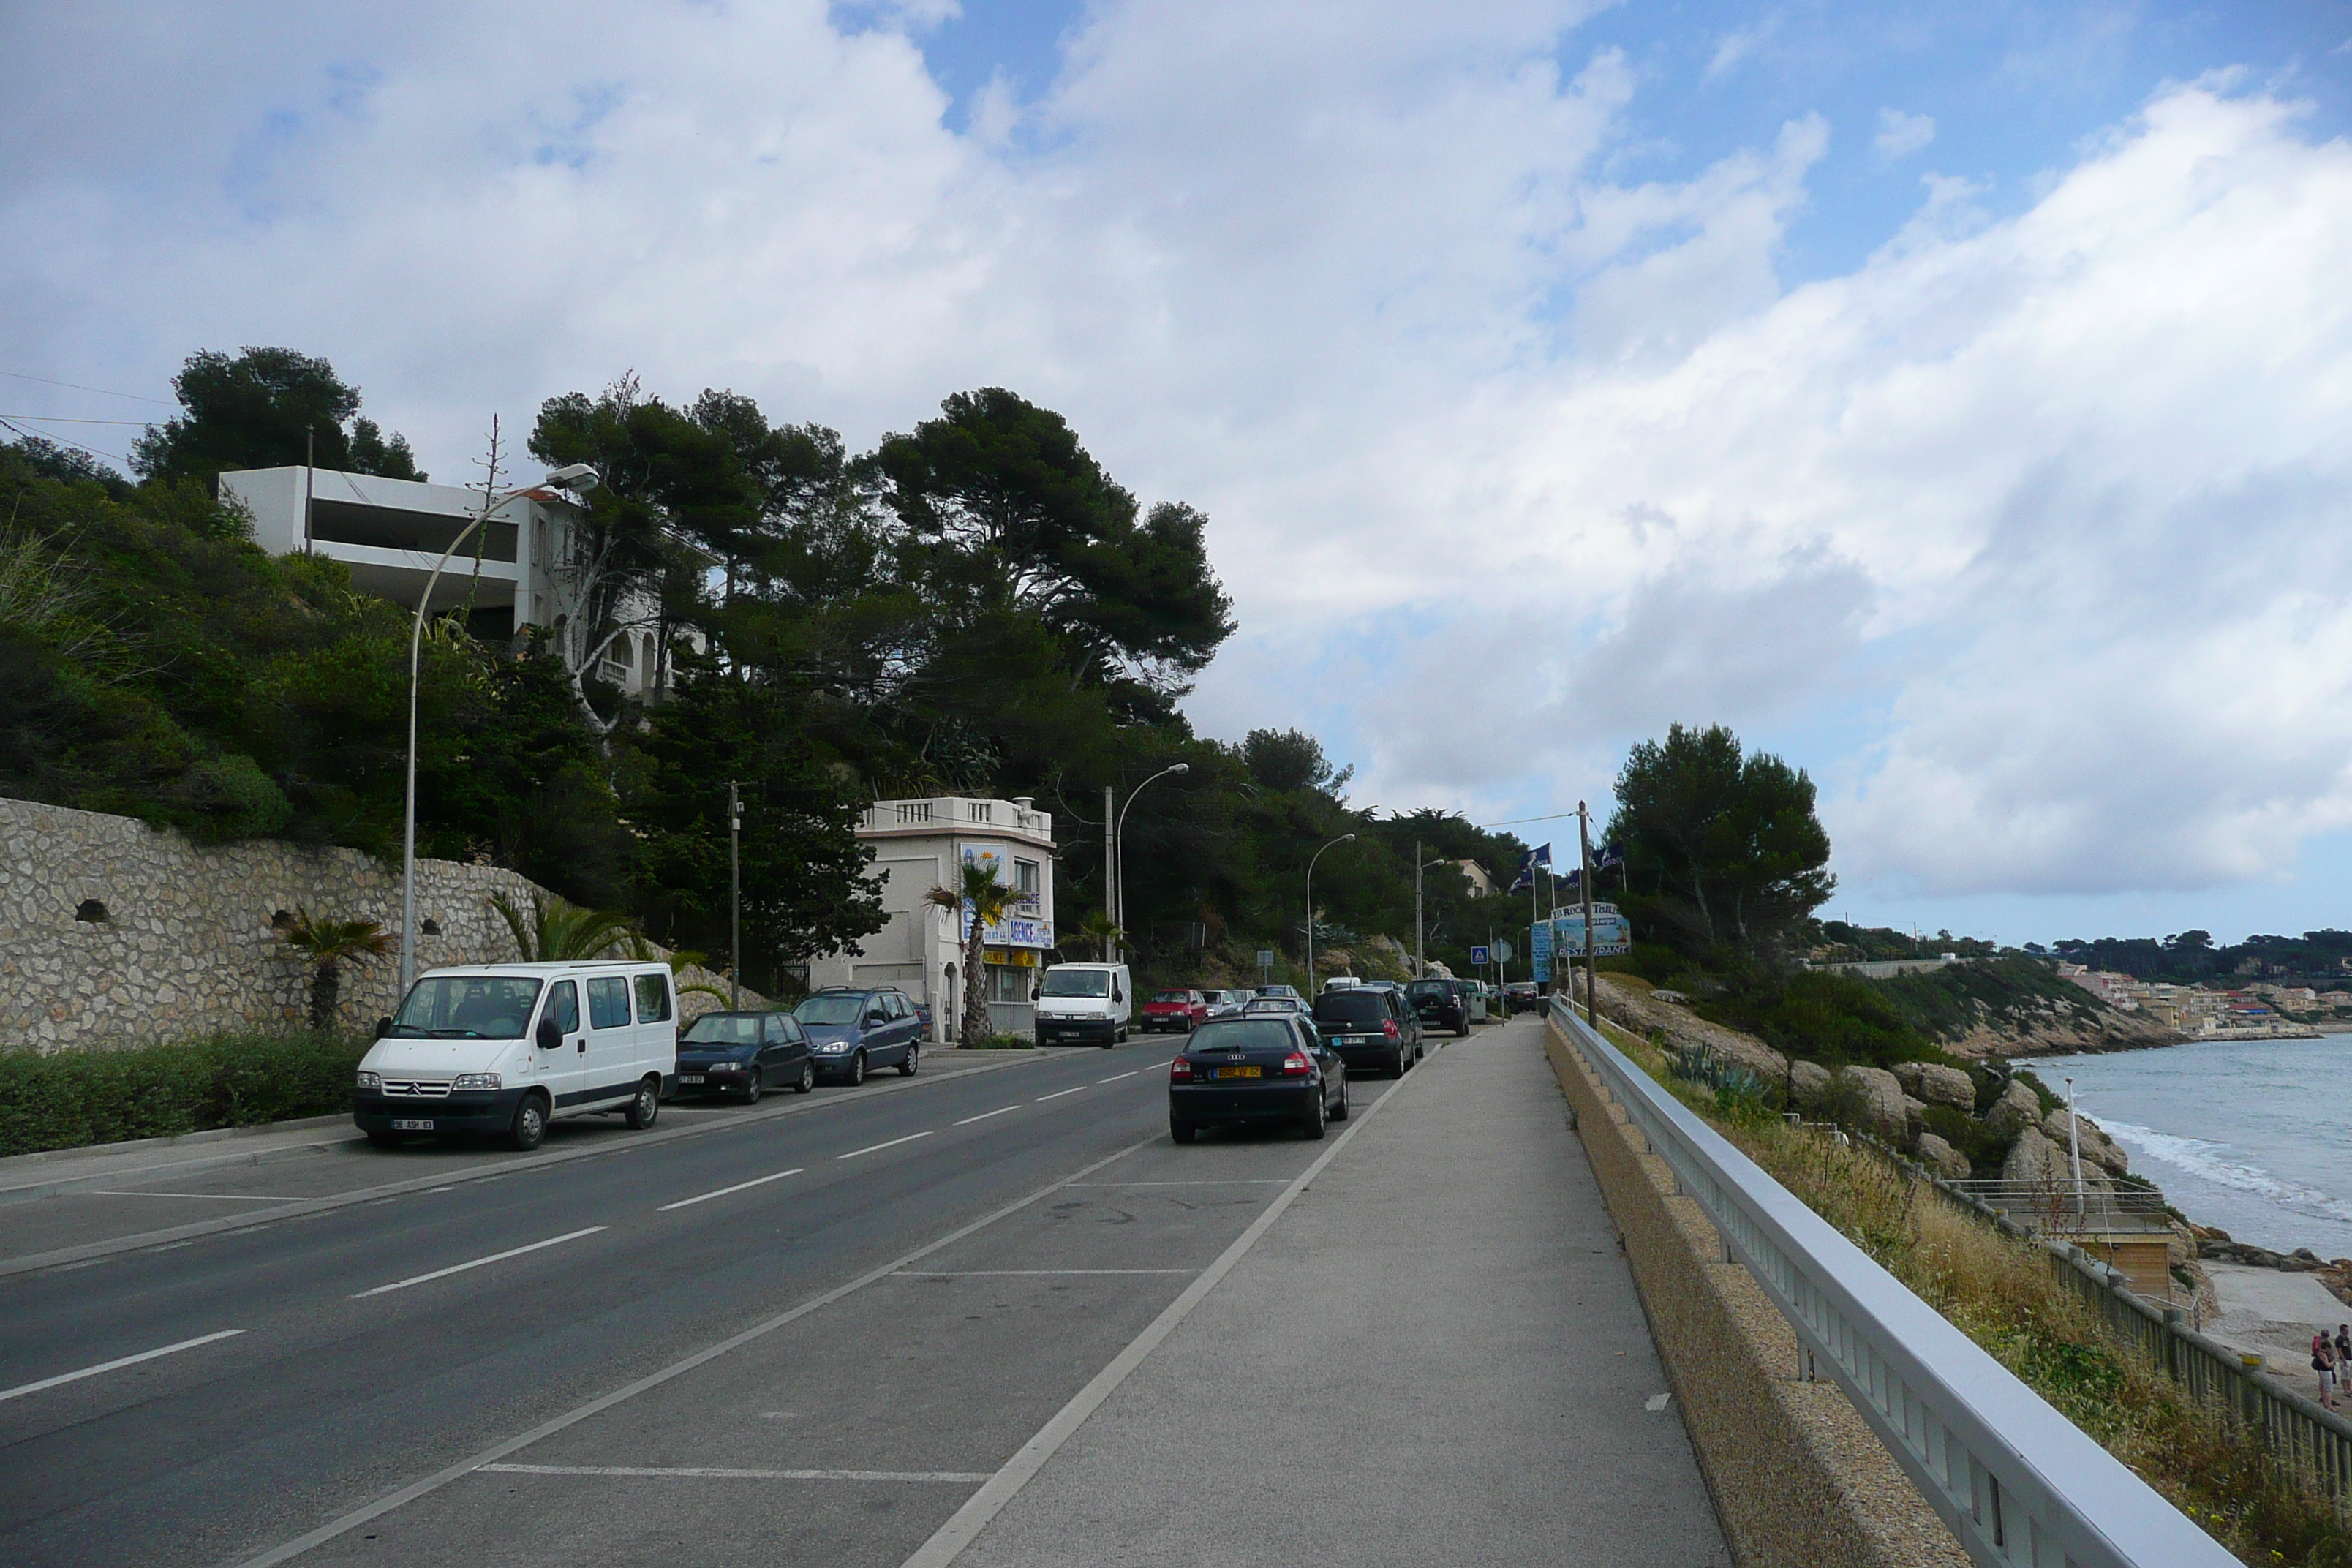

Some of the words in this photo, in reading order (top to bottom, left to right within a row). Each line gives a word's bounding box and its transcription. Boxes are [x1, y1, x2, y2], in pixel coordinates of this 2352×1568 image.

[1010, 921, 1033, 944] AGENCE
[1250, 1067, 1259, 1075] 62
[407, 1120, 419, 1128] ASH
